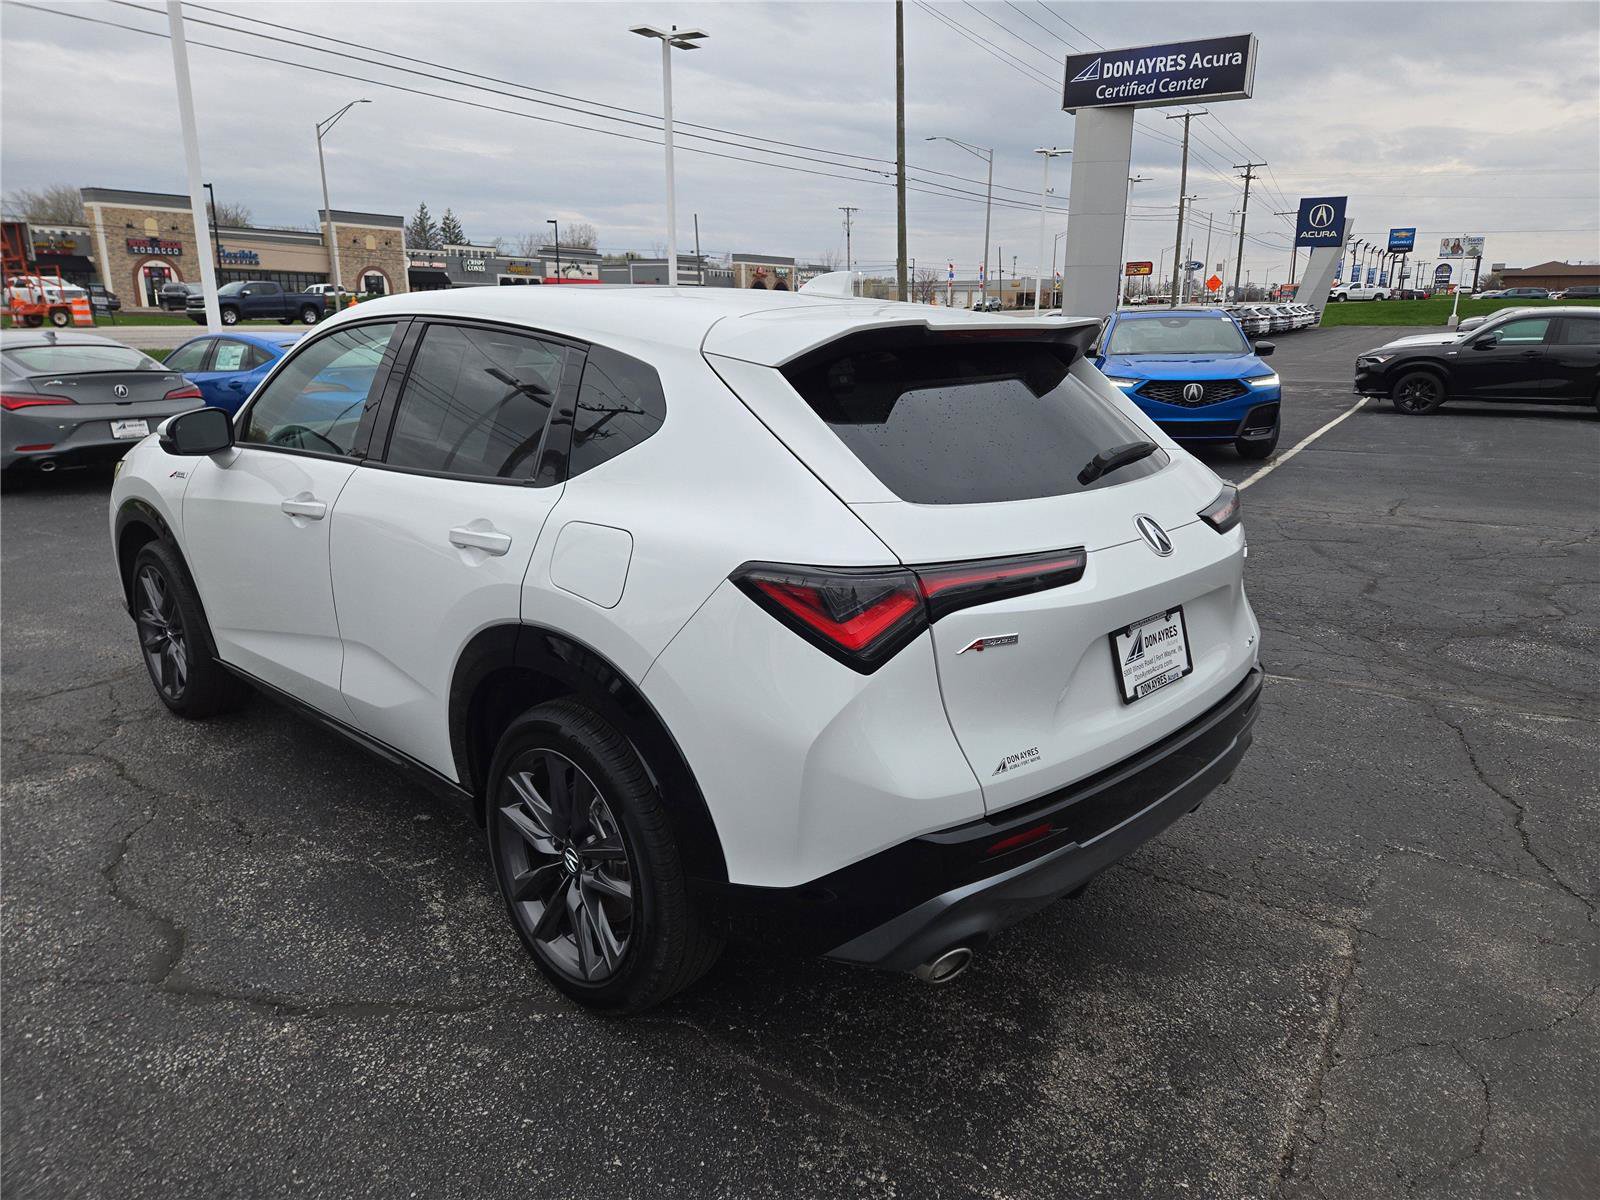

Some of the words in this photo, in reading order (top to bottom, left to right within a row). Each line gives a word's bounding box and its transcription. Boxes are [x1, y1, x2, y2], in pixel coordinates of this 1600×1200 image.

[1102, 60, 1134, 79] DON
[1135, 54, 1187, 76] AYRES
[1189, 51, 1242, 70] Acura
[1095, 79, 1156, 99] Certified
[1158, 76, 1209, 95] Center
[1300, 230, 1337, 239] ACURA
[132, 244, 179, 253] TOBACCO
[1144, 632, 1158, 649] DON
[1157, 624, 1179, 643] AYRES
[1140, 683, 1152, 695] DON
[1151, 674, 1168, 690] AYRES
[1006, 754, 1020, 765] DON
[1019, 746, 1040, 760] AYRES
